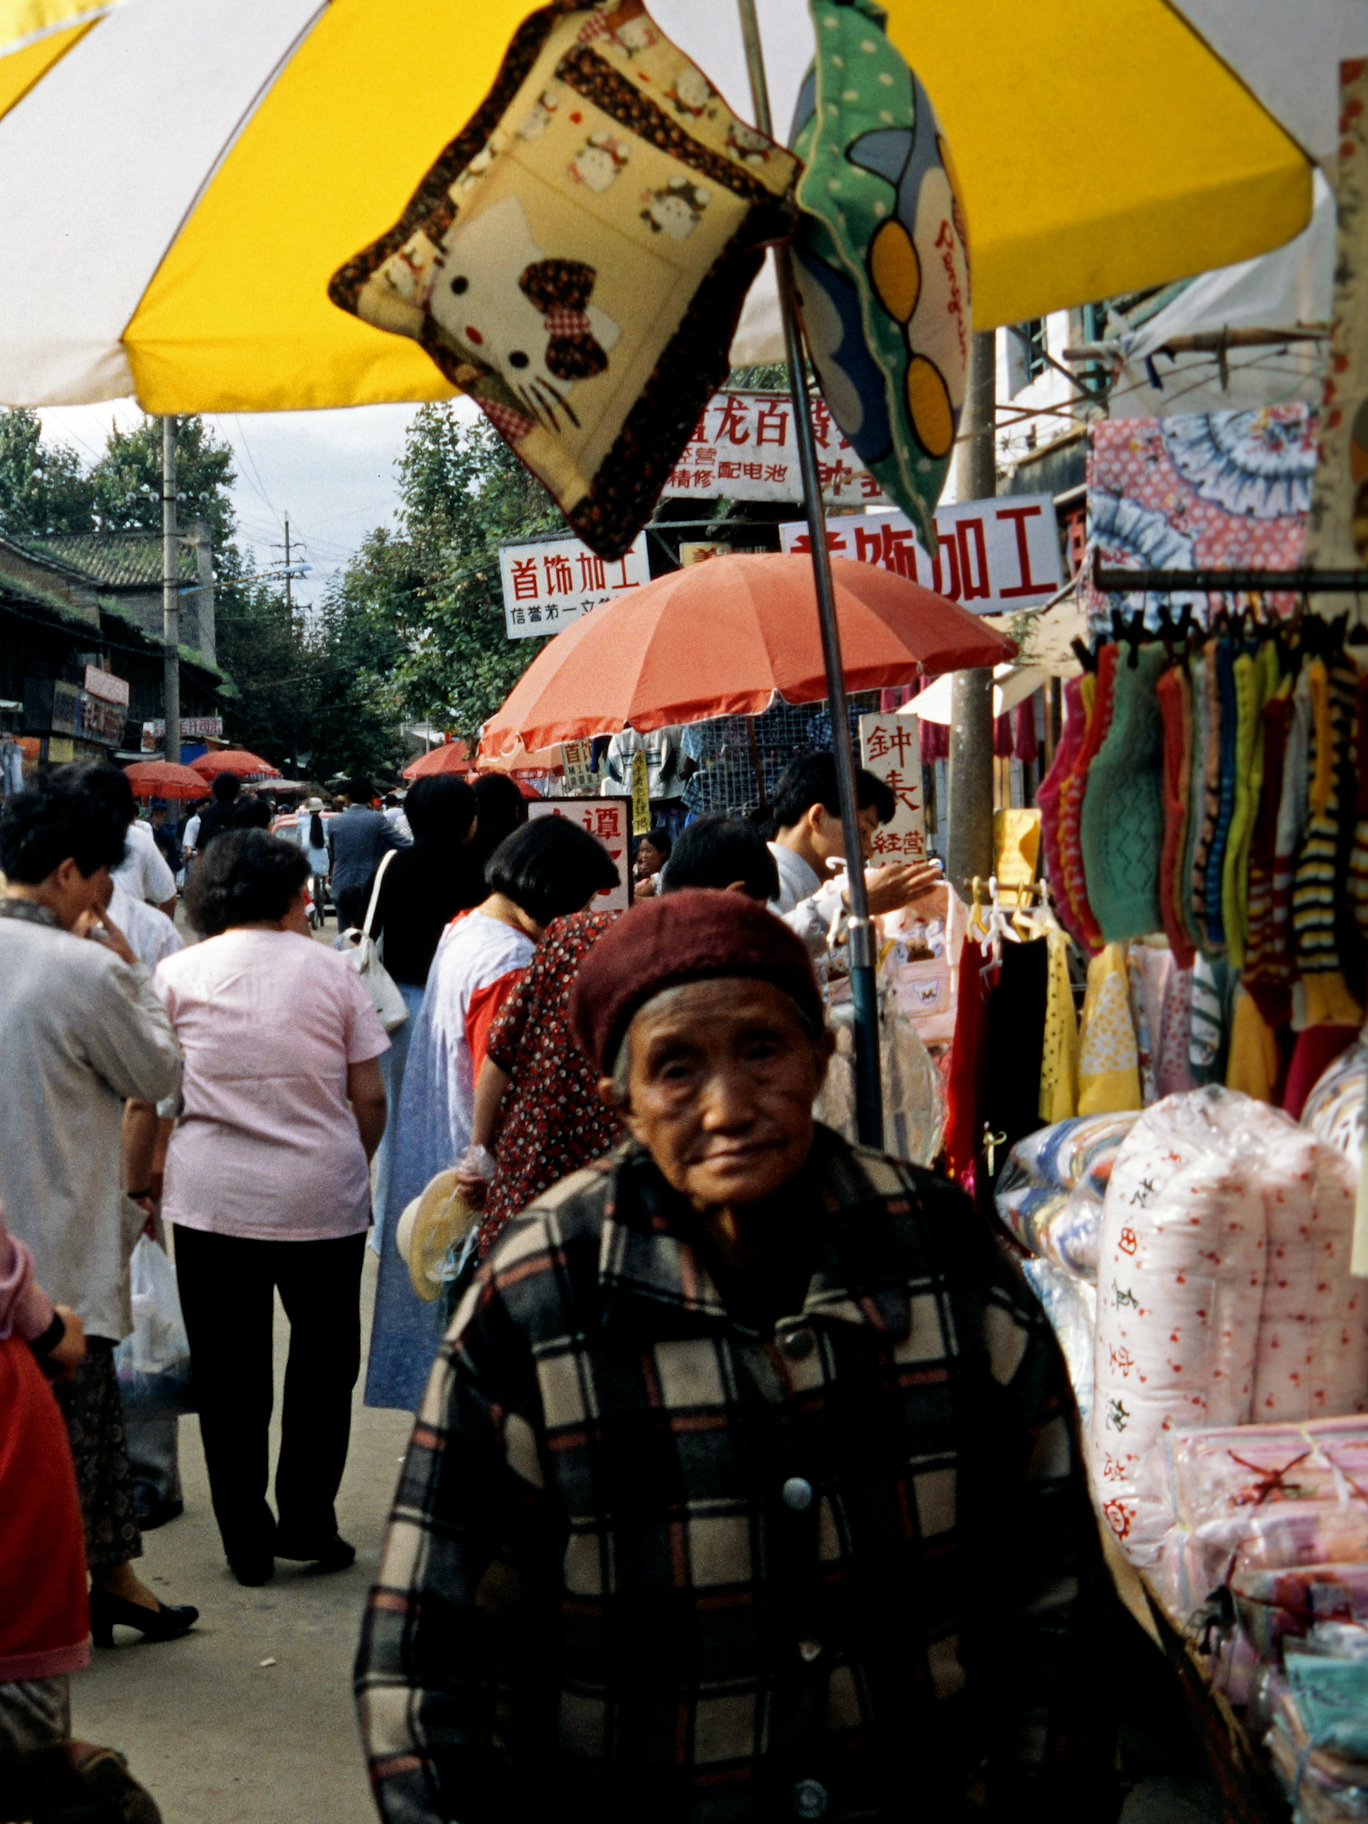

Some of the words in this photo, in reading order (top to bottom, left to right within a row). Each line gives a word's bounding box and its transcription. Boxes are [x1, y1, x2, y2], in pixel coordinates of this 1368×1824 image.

[688, 396, 853, 450] 龙百货
[717, 461, 789, 483] 配电池
[510, 549, 641, 601] 首饰加工
